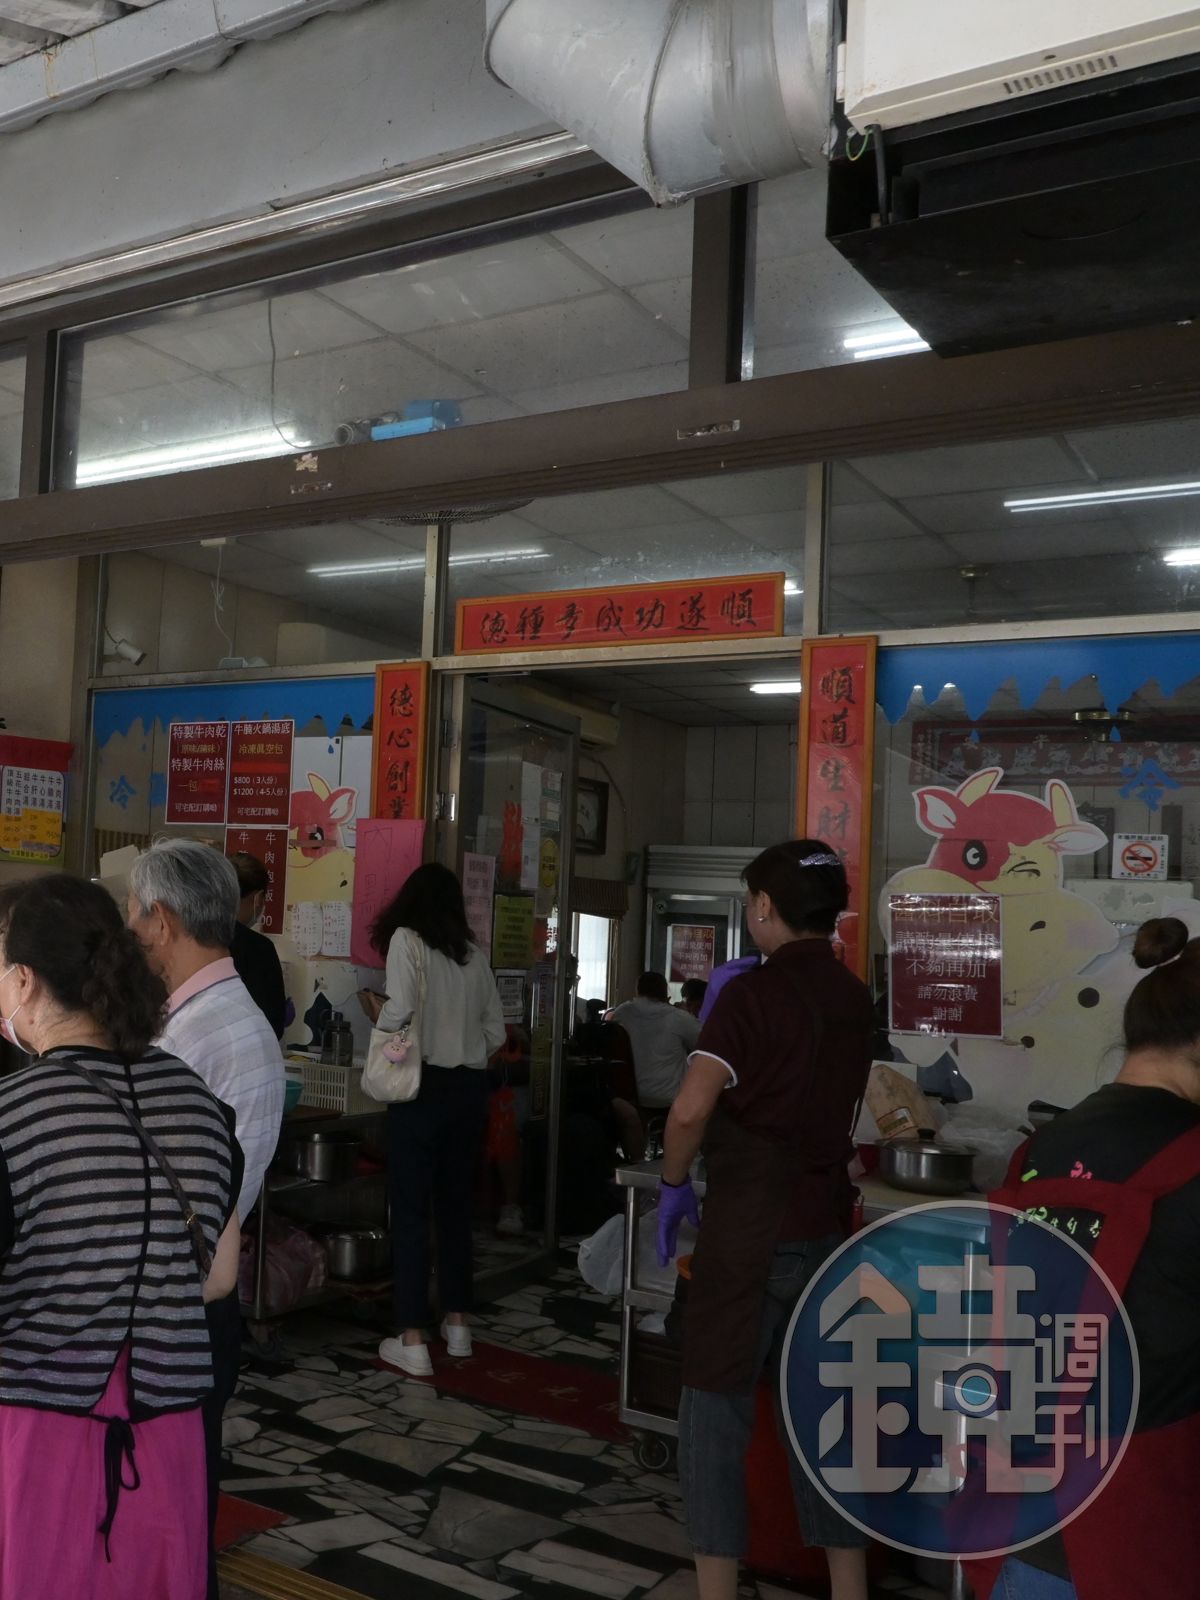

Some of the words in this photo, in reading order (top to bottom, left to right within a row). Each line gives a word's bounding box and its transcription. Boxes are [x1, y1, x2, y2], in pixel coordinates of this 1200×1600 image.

[171, 724, 227, 739] 特製牛肉乾
[233, 723, 291, 736] 牛腩火鍋湯底
[170, 758, 225, 772] 特製牛肉絲
[905, 957, 988, 979] 不夠再加
[916, 985, 979, 1002] 請勿浪費
[931, 1006, 964, 1022] 謝謝
